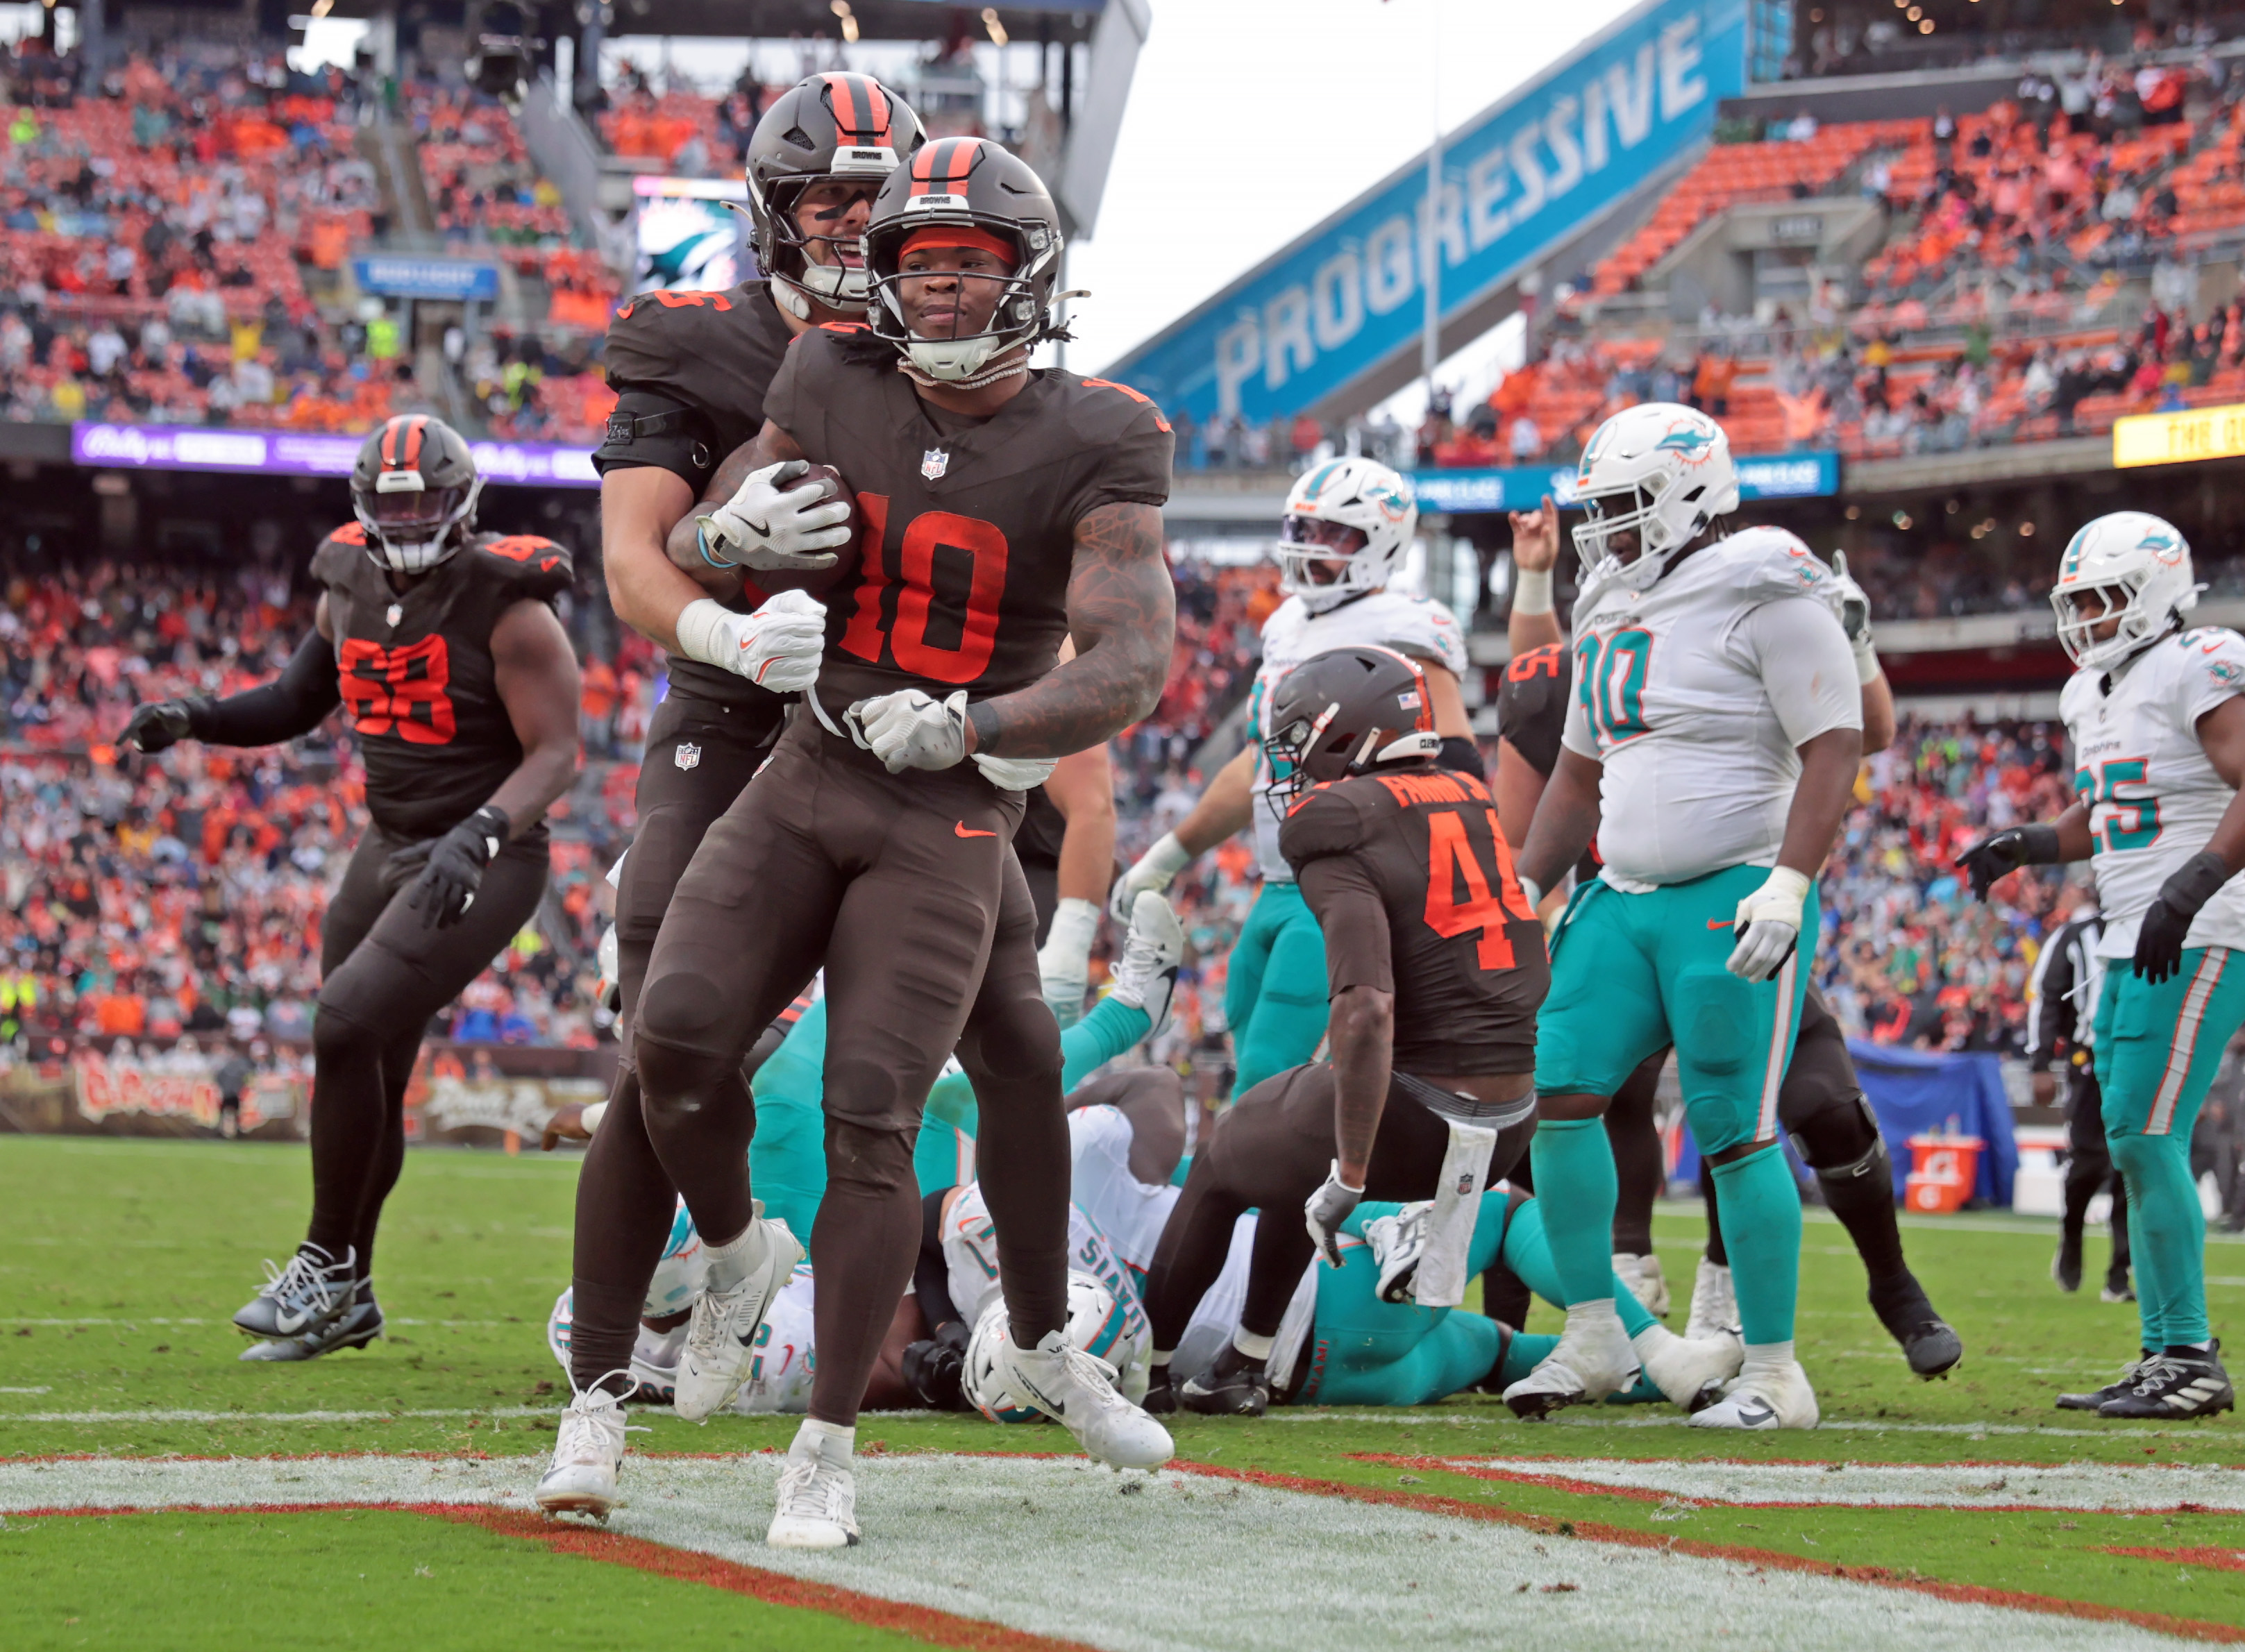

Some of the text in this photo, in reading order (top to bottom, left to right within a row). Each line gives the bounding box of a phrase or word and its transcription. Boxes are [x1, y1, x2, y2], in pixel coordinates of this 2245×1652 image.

[851, 151, 882, 160] BROWNS
[919, 196, 951, 205] BROWNS
[1216, 12, 1708, 421] PROGRESSIVE
[838, 491, 1009, 684] 10
[337, 632, 457, 745] 68
[679, 754, 697, 765] NFL
[1079, 1236, 1147, 1335] DAVIS
[1306, 1339, 1329, 1398] MIAMI
